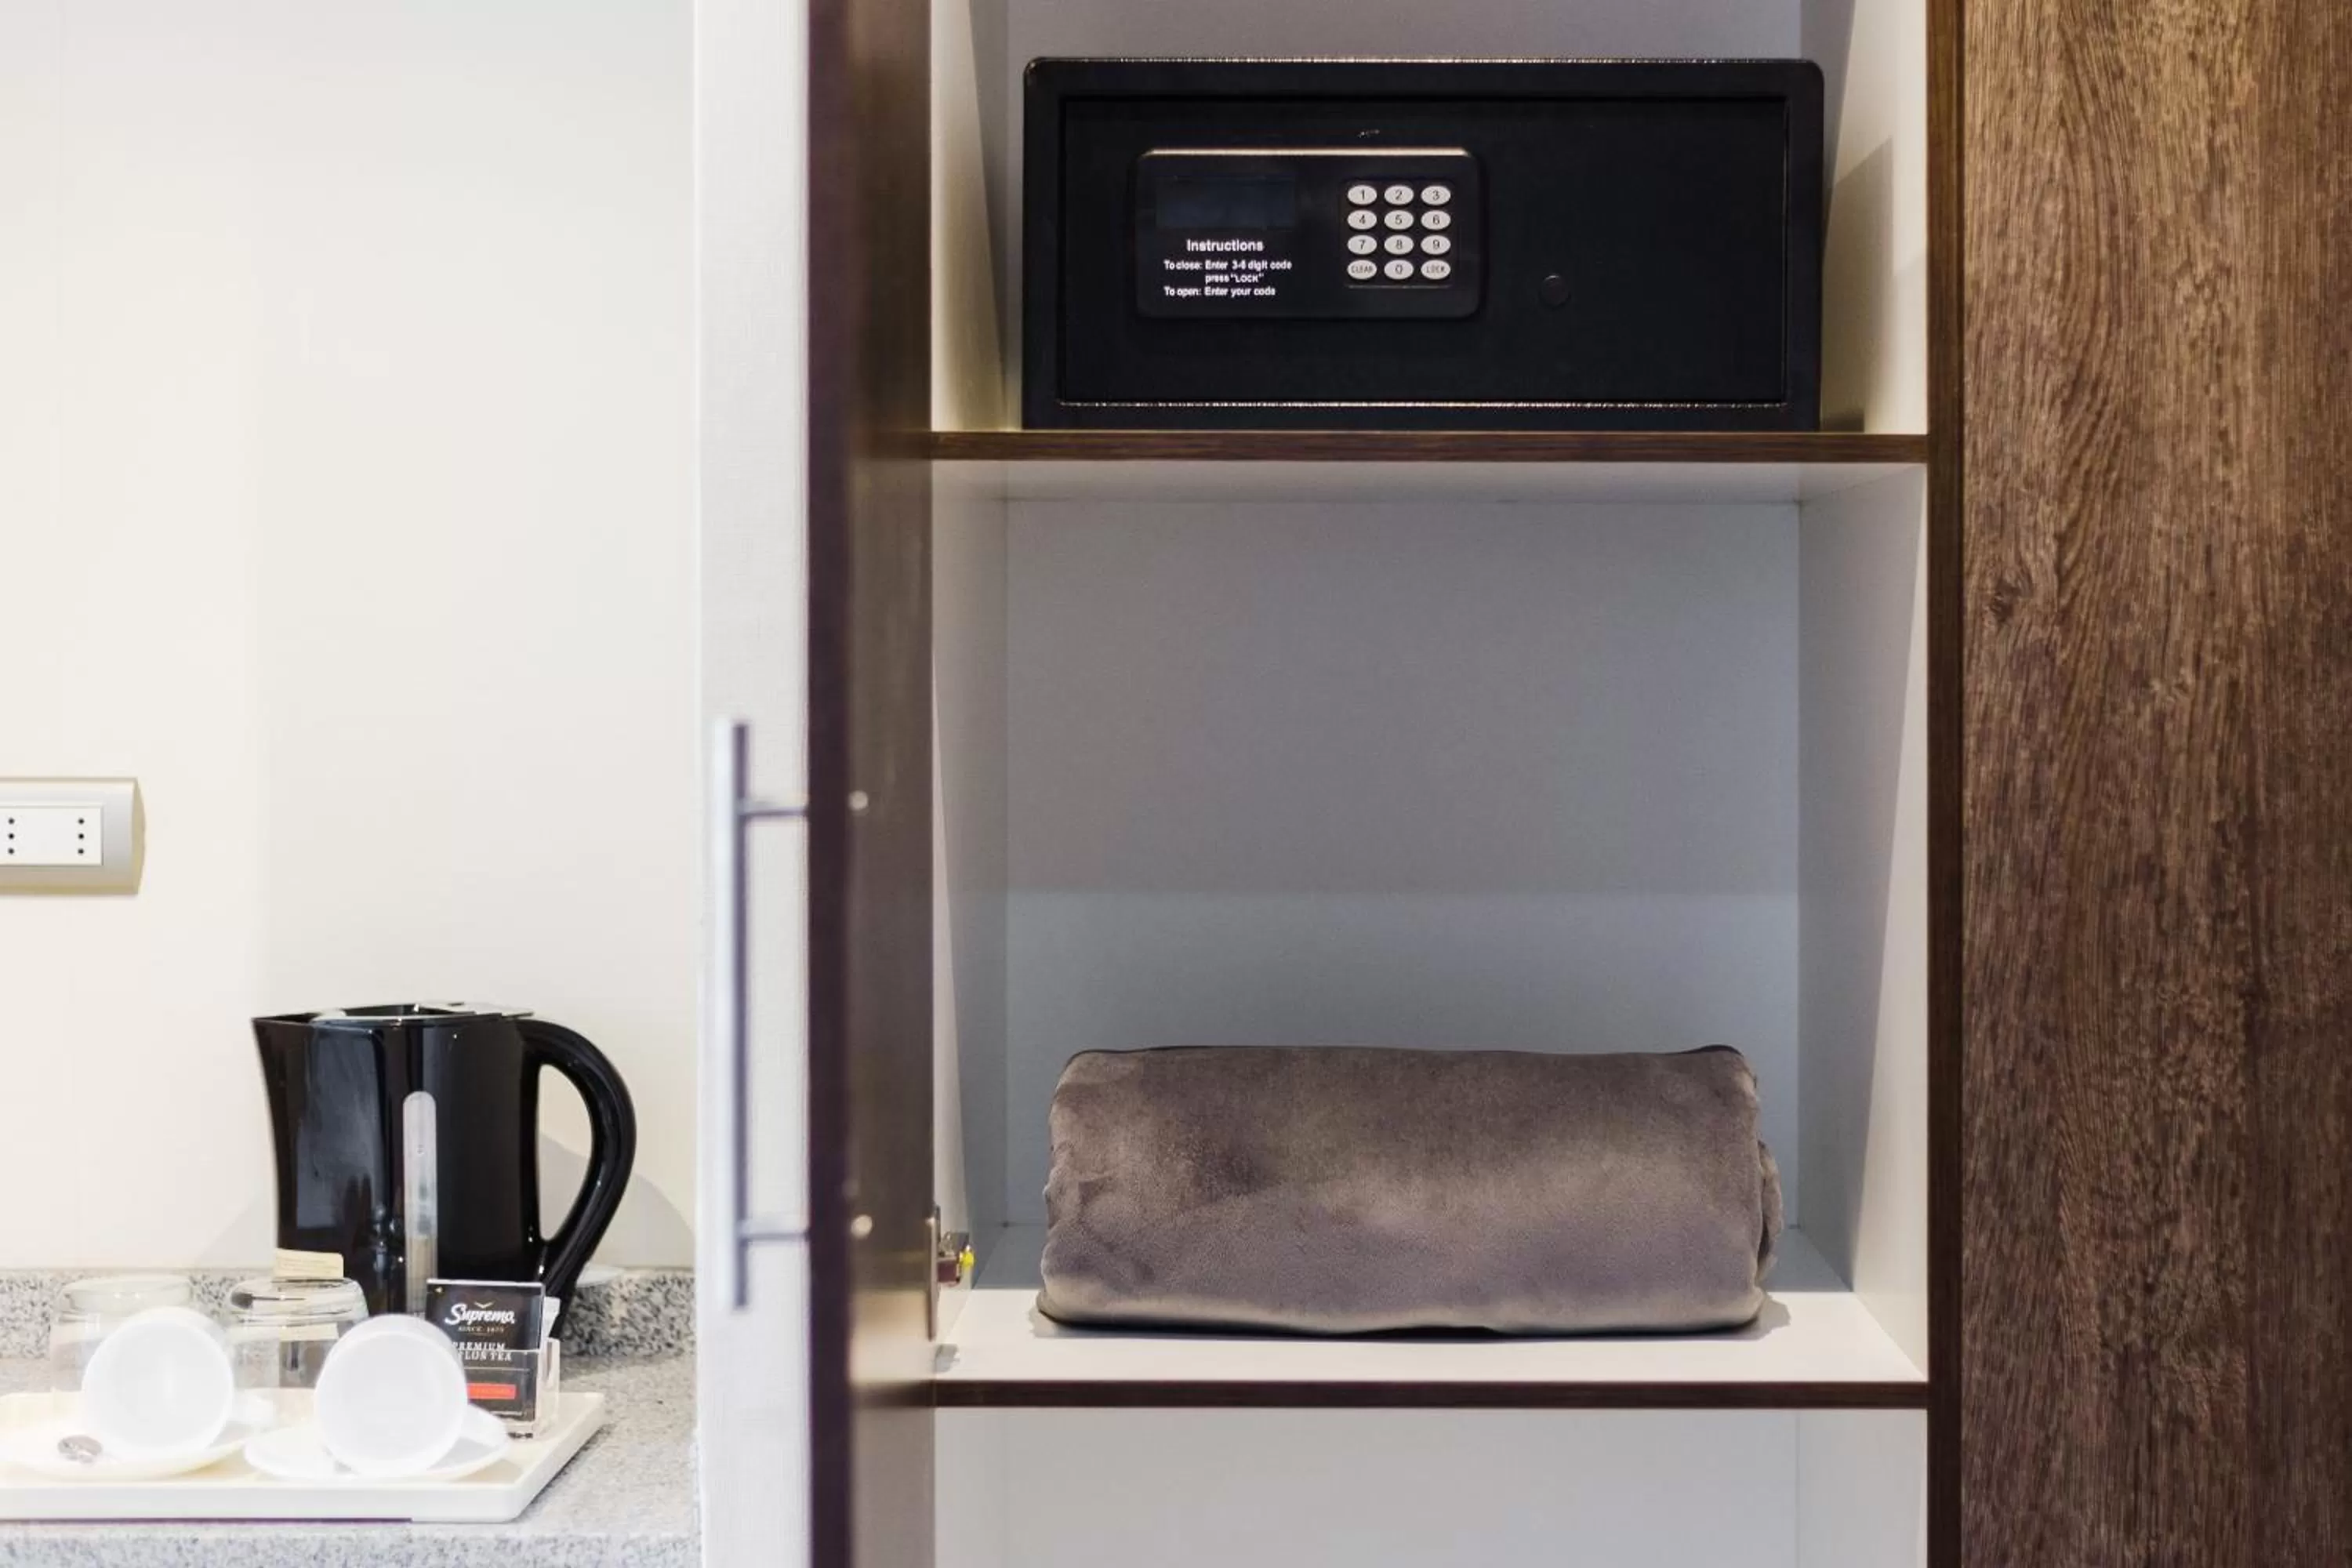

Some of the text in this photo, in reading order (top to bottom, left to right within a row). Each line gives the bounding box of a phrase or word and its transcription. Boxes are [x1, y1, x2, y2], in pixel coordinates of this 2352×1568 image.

[1395, 189, 1403, 201] 2
[1432, 190, 1440, 201] 3
[1359, 214, 1440, 225] 4 5 6
[1185, 238, 1265, 252] Instructions
[1359, 239, 1440, 250] 7 8 9
[1163, 260, 1175, 270] To
[1175, 260, 1203, 270] close:
[1205, 260, 1229, 270] Enter
[1248, 260, 1268, 271] digit
[1269, 260, 1293, 270] code
[1395, 264, 1403, 274] 0
[1204, 274, 1229, 285] press
[1163, 285, 1276, 298] To open: Enter your code
